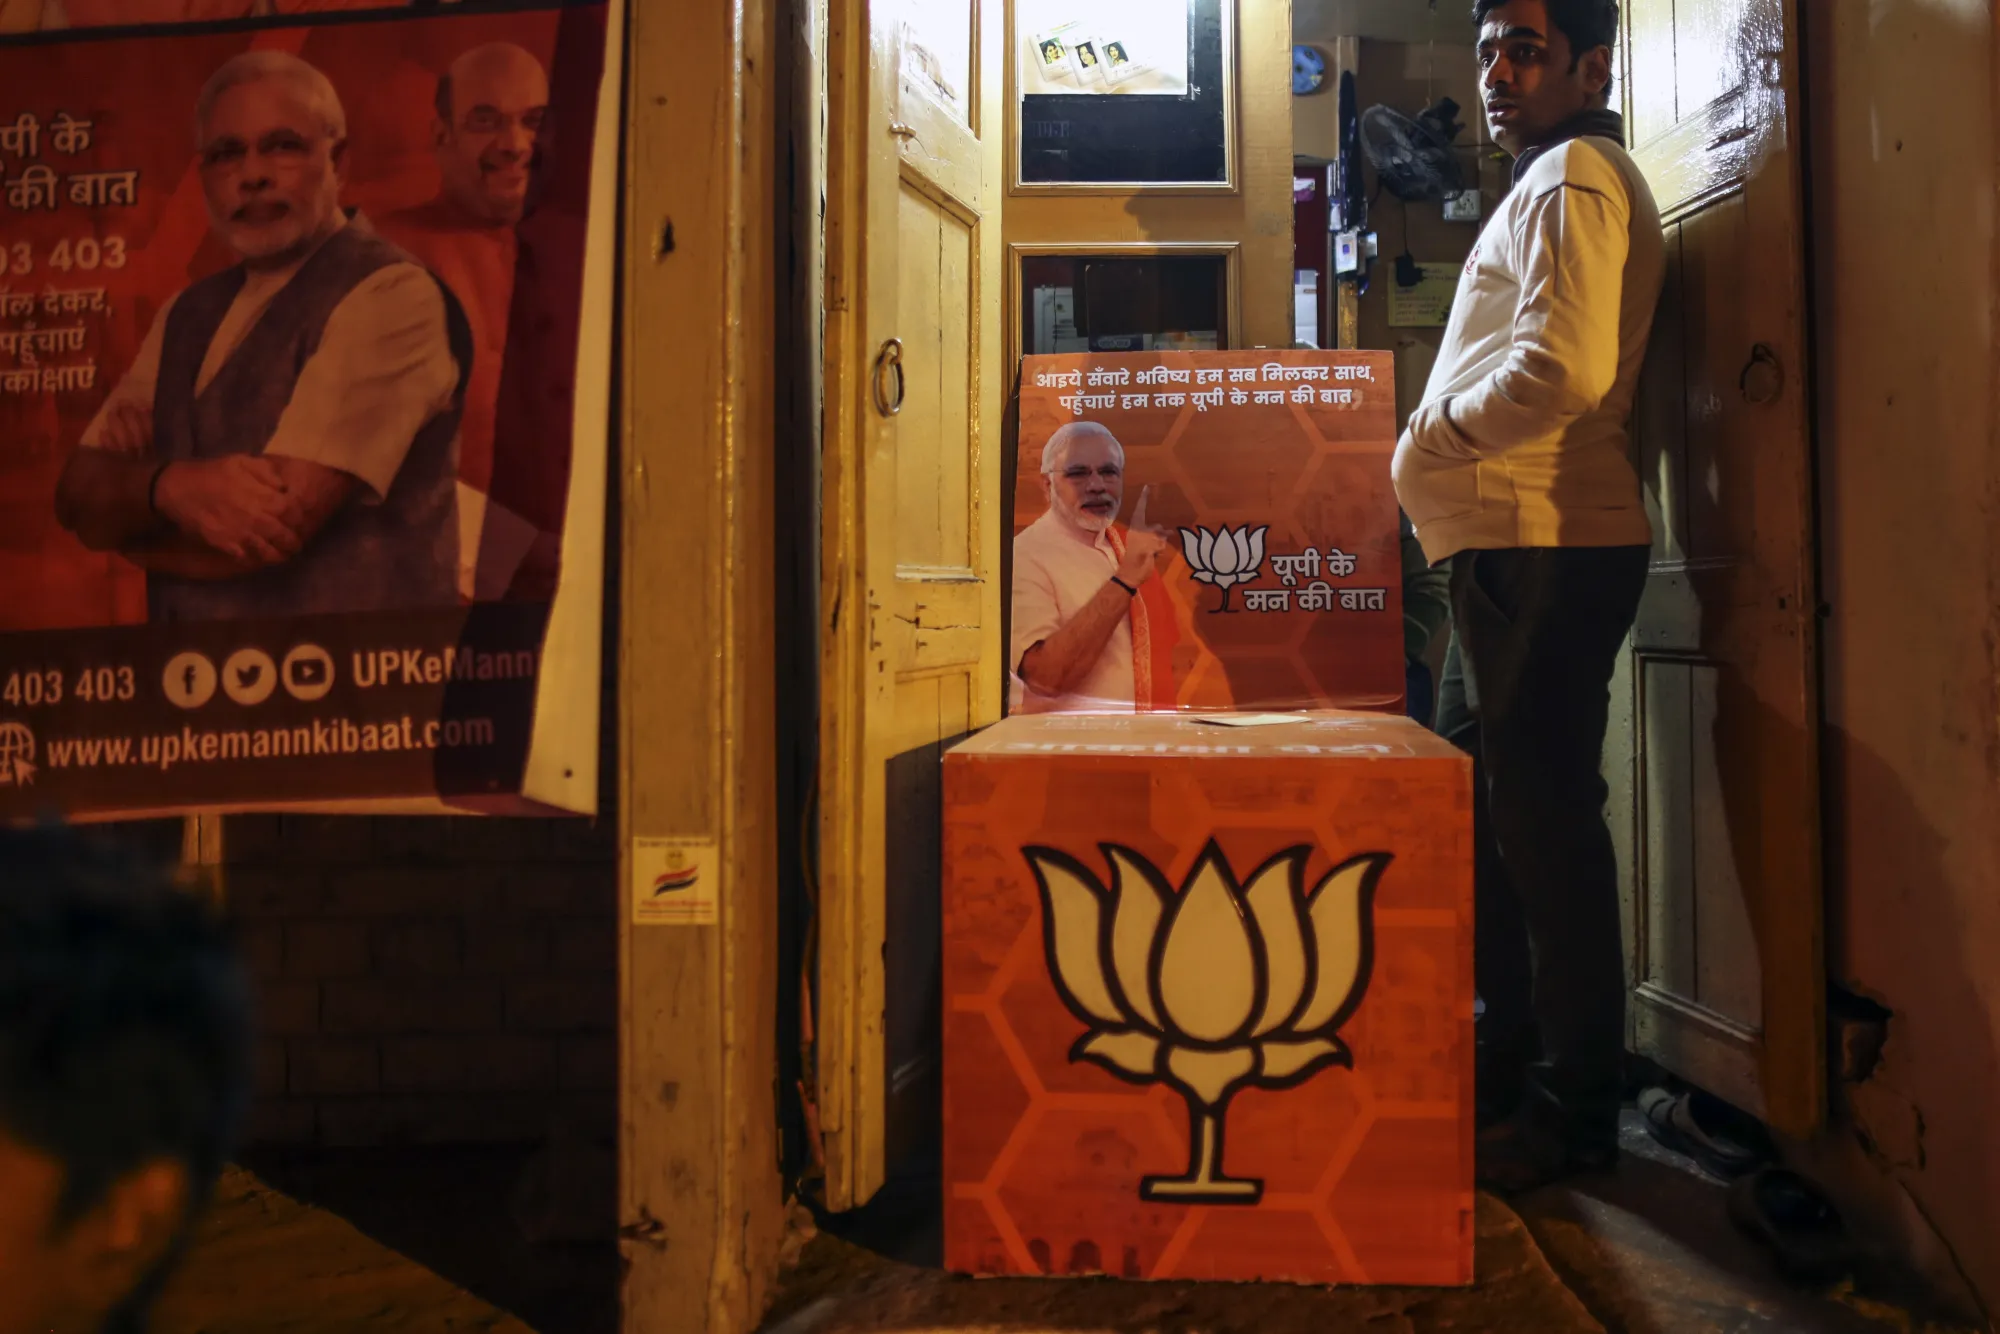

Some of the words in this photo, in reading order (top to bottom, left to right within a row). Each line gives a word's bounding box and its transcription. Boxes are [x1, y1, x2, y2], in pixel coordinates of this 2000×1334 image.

[0, 112, 41, 159] पी
[49, 112, 93, 155] के
[4, 164, 59, 211] की
[67, 170, 139, 206] बात
[48, 235, 127, 272] 403
[0, 284, 35, 318] ॉल
[0, 357, 97, 396] कांक्षाएं
[1036, 368, 1082, 389] आइये
[1086, 365, 1131, 387] सँवारे
[1136, 365, 1191, 386] भविष्य
[1195, 368, 1224, 388] हम
[1228, 367, 1257, 383] सब
[1261, 362, 1330, 382] मिलकर
[1333, 364, 1376, 384] साथ,
[1058, 389, 1116, 416] पहुँचाएं
[1121, 393, 1150, 410] हम
[1153, 392, 1186, 409] तक
[1190, 387, 1225, 412] यूपी
[1229, 387, 1249, 406] के
[1253, 389, 1285, 405] मन
[1289, 384, 1316, 405] की
[1270, 547, 1322, 587] यूपी
[1325, 548, 1358, 577] के
[1243, 588, 1291, 612] मन
[1295, 580, 1335, 612] की
[1338, 587, 1387, 611] बात
[3, 669, 64, 707] 403
[75, 665, 137, 702] 403
[352, 645, 540, 688] UPKeMann
[47, 716, 495, 773] www.upkemannkibaat.com
